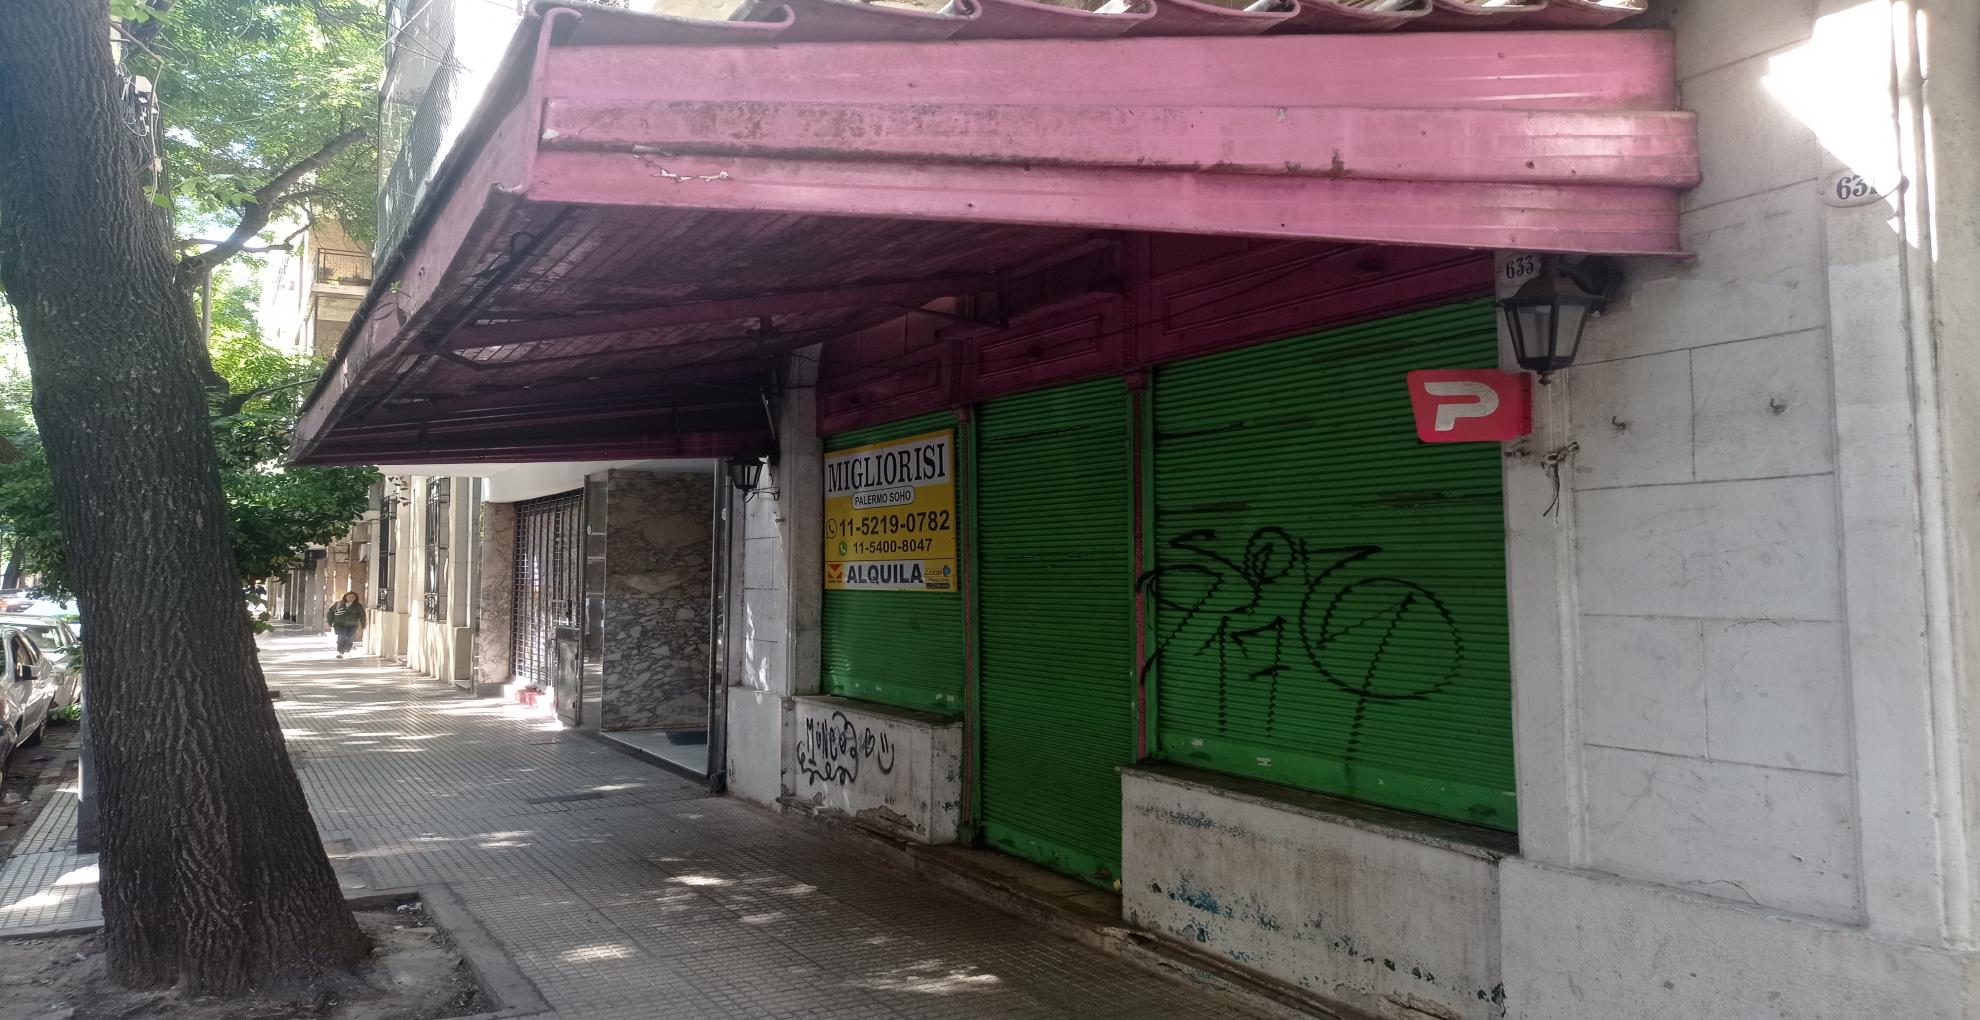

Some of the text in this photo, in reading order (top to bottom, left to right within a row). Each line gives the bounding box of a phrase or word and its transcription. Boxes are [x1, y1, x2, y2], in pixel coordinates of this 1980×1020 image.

[1505, 255, 1534, 279] 633
[1424, 382, 1499, 431] P
[828, 443, 945, 492] MIGLIORISI
[854, 490, 911, 506] PALERMO SOHO
[840, 510, 950, 537] 11-5219-0782
[853, 539, 932, 554] 11-5400-8047
[847, 564, 923, 585] ALQUILA
